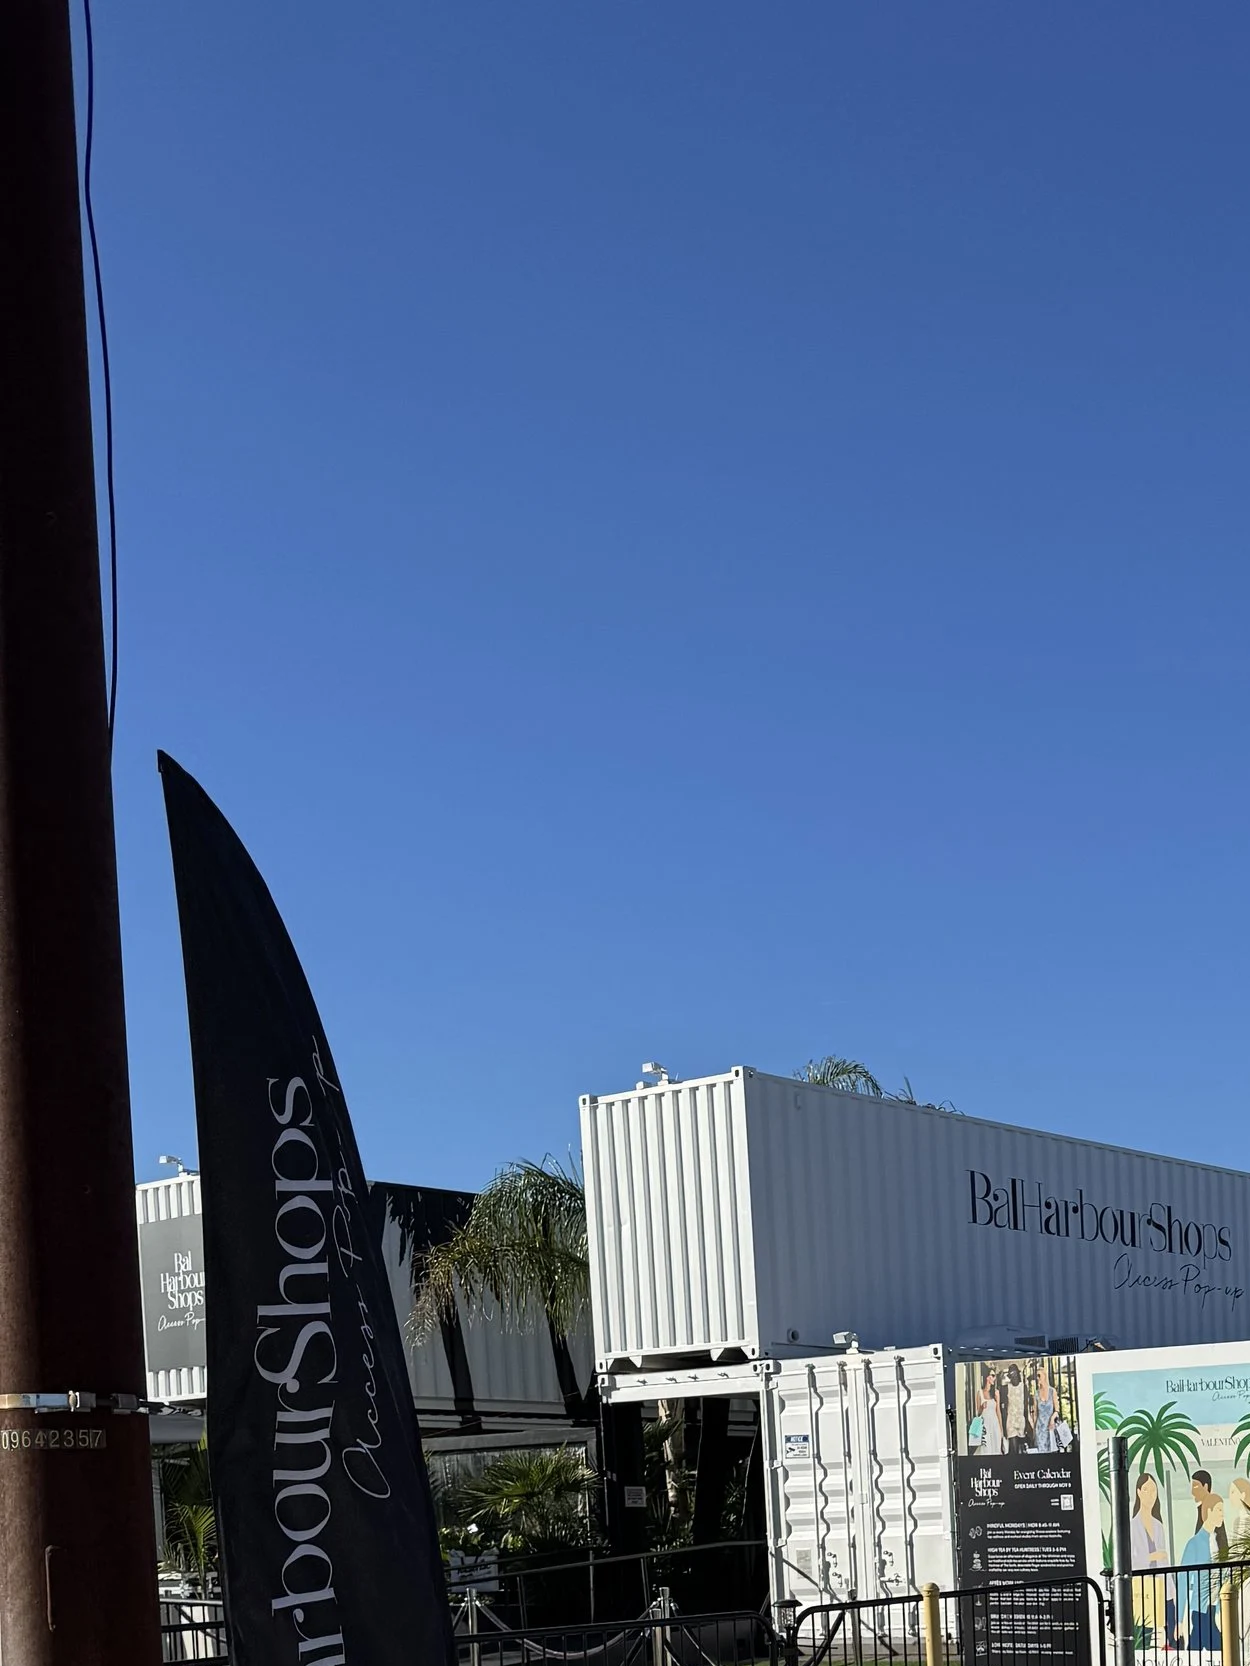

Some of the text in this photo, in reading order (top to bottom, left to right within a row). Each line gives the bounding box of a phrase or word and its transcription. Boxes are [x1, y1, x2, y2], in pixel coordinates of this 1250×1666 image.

[173, 1250, 193, 1273] Bal
[160, 1271, 205, 1293] Harbou
[1113, 1252, 1245, 1312] Access Pop-up
[167, 1290, 204, 1311] Shops
[341, 1285, 391, 1499] Access
[970, 1477, 1003, 1488] Harbour
[979, 1468, 992, 1479] Bal
[1013, 1468, 1072, 1480] Event Calendar
[974, 1487, 999, 1498] Shops
